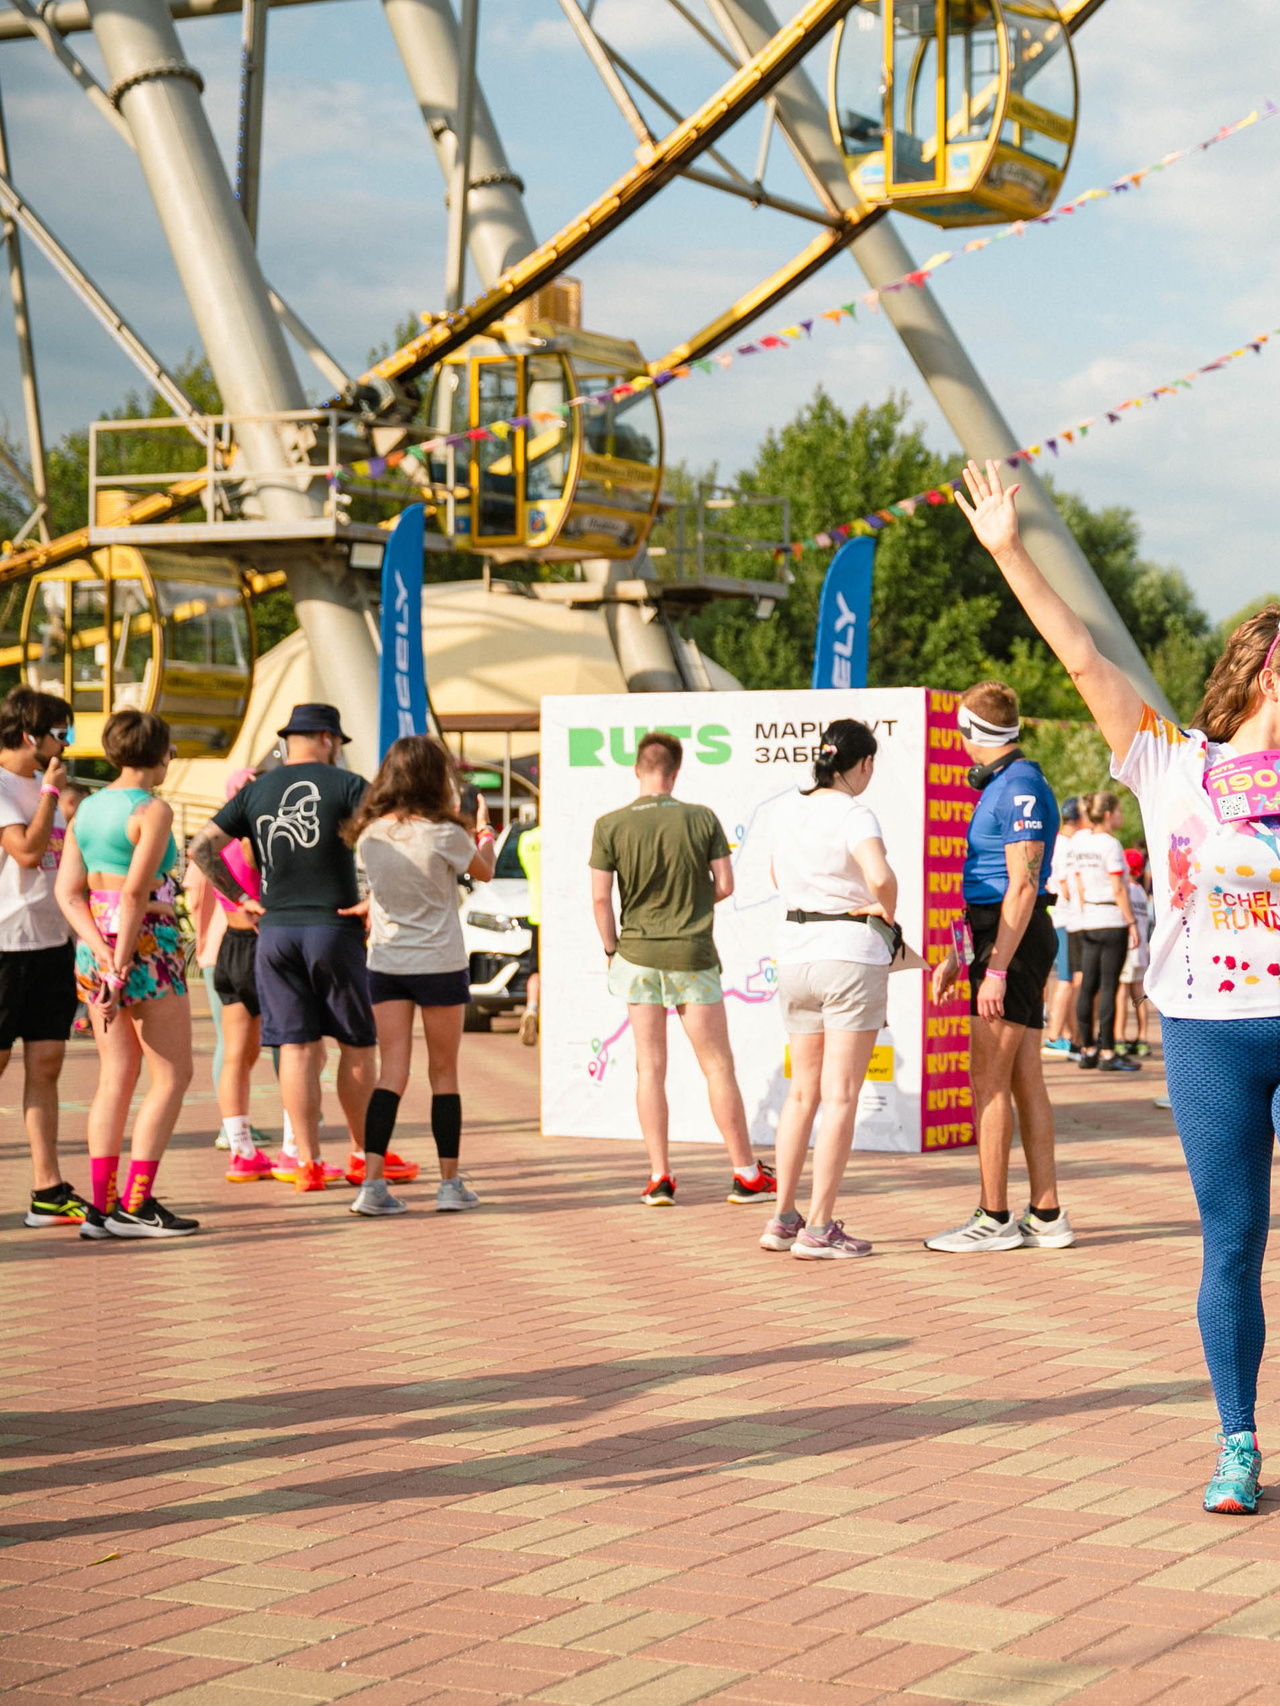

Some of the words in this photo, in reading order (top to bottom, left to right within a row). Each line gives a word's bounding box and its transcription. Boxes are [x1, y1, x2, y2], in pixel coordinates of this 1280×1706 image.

[929, 726, 963, 751] RUT
[755, 746, 820, 763] ЗАБЕ
[1212, 769, 1279, 795] 190
[929, 799, 975, 823] RUTS
[1013, 794, 1037, 818] 7
[928, 871, 963, 894] RUT
[928, 908, 963, 930] RUT
[926, 1016, 971, 1038] RUTS
[926, 1051, 971, 1075] RUTS
[926, 1086, 973, 1111] RUTS
[925, 1122, 973, 1147] RUTS
